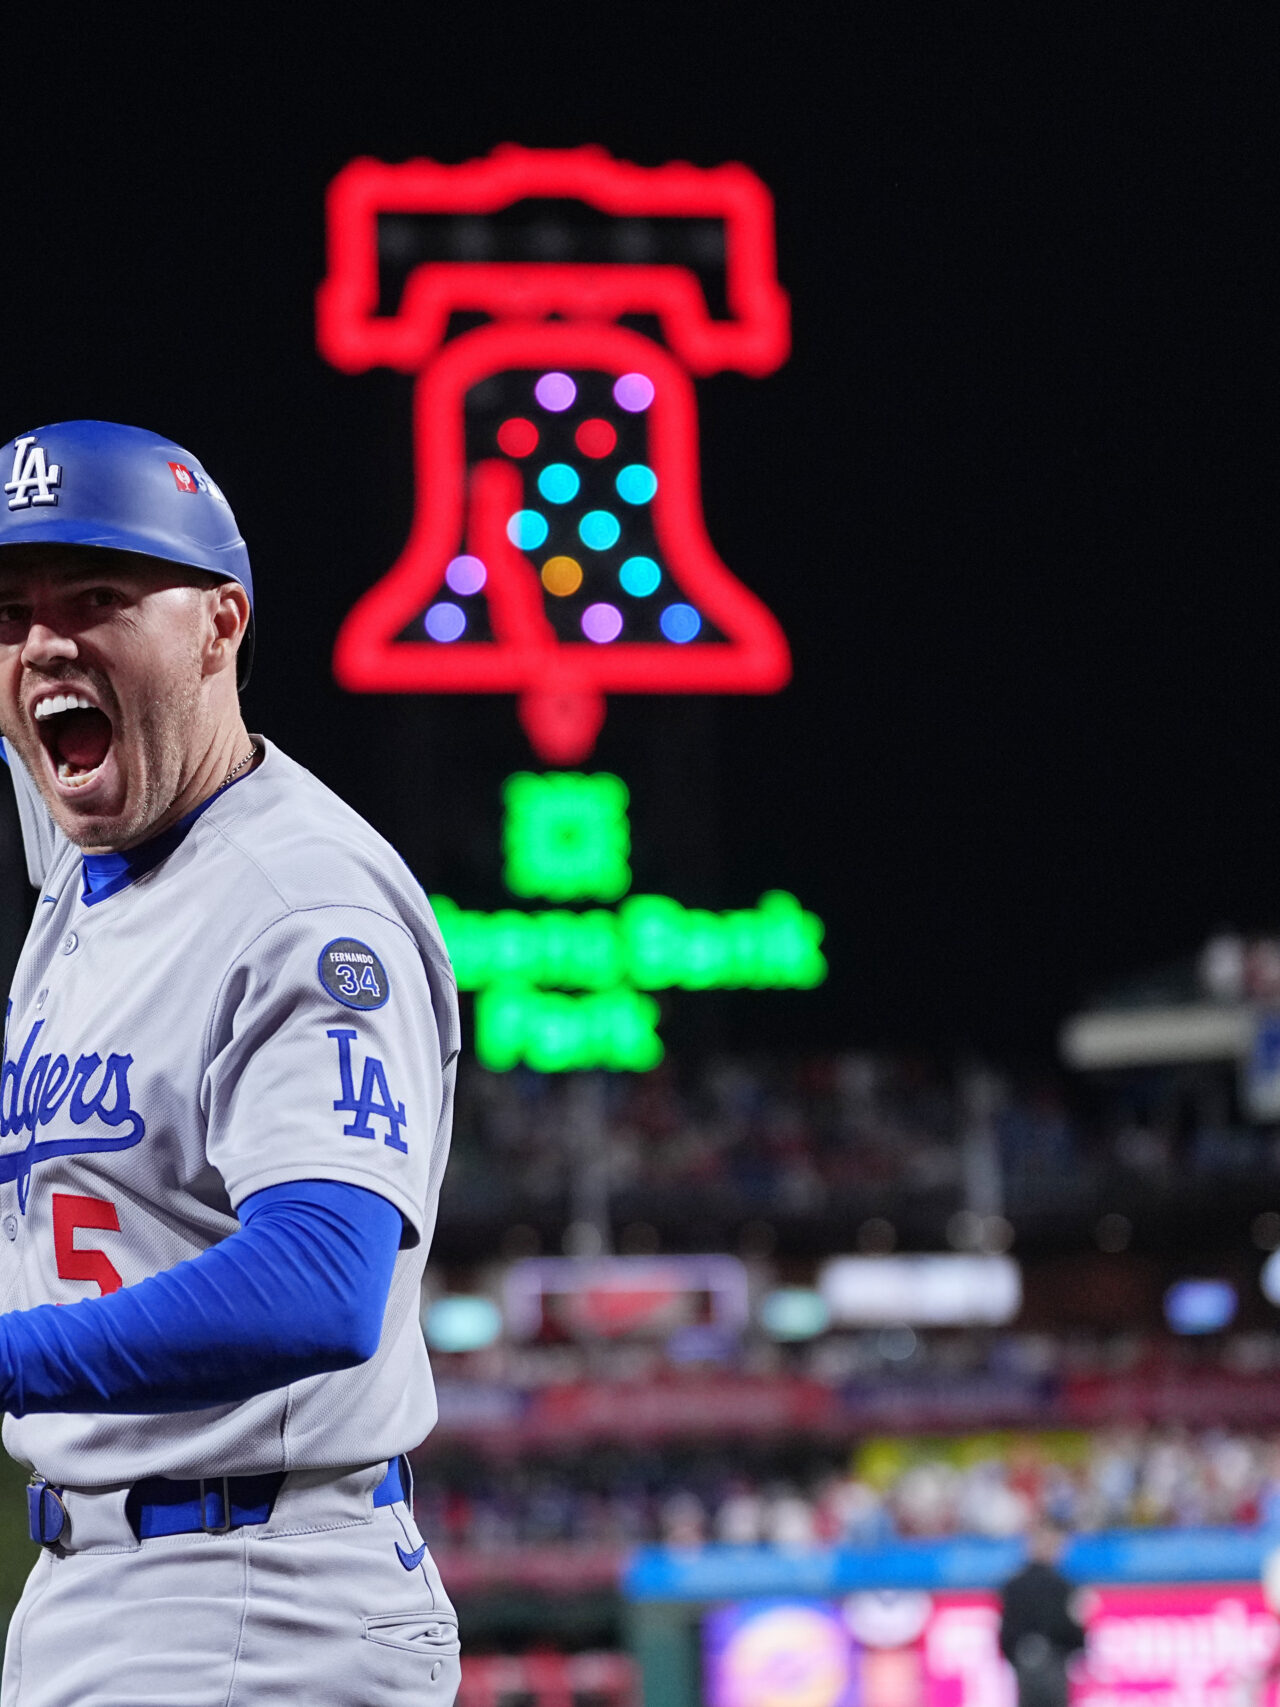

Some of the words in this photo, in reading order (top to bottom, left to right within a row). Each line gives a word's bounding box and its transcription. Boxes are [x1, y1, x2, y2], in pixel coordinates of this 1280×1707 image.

[4, 436, 60, 506] LA
[329, 952, 374, 964] FERNANDO
[335, 964, 380, 997] 34
[326, 1028, 408, 1154] LA
[52, 1193, 122, 1298] 5
